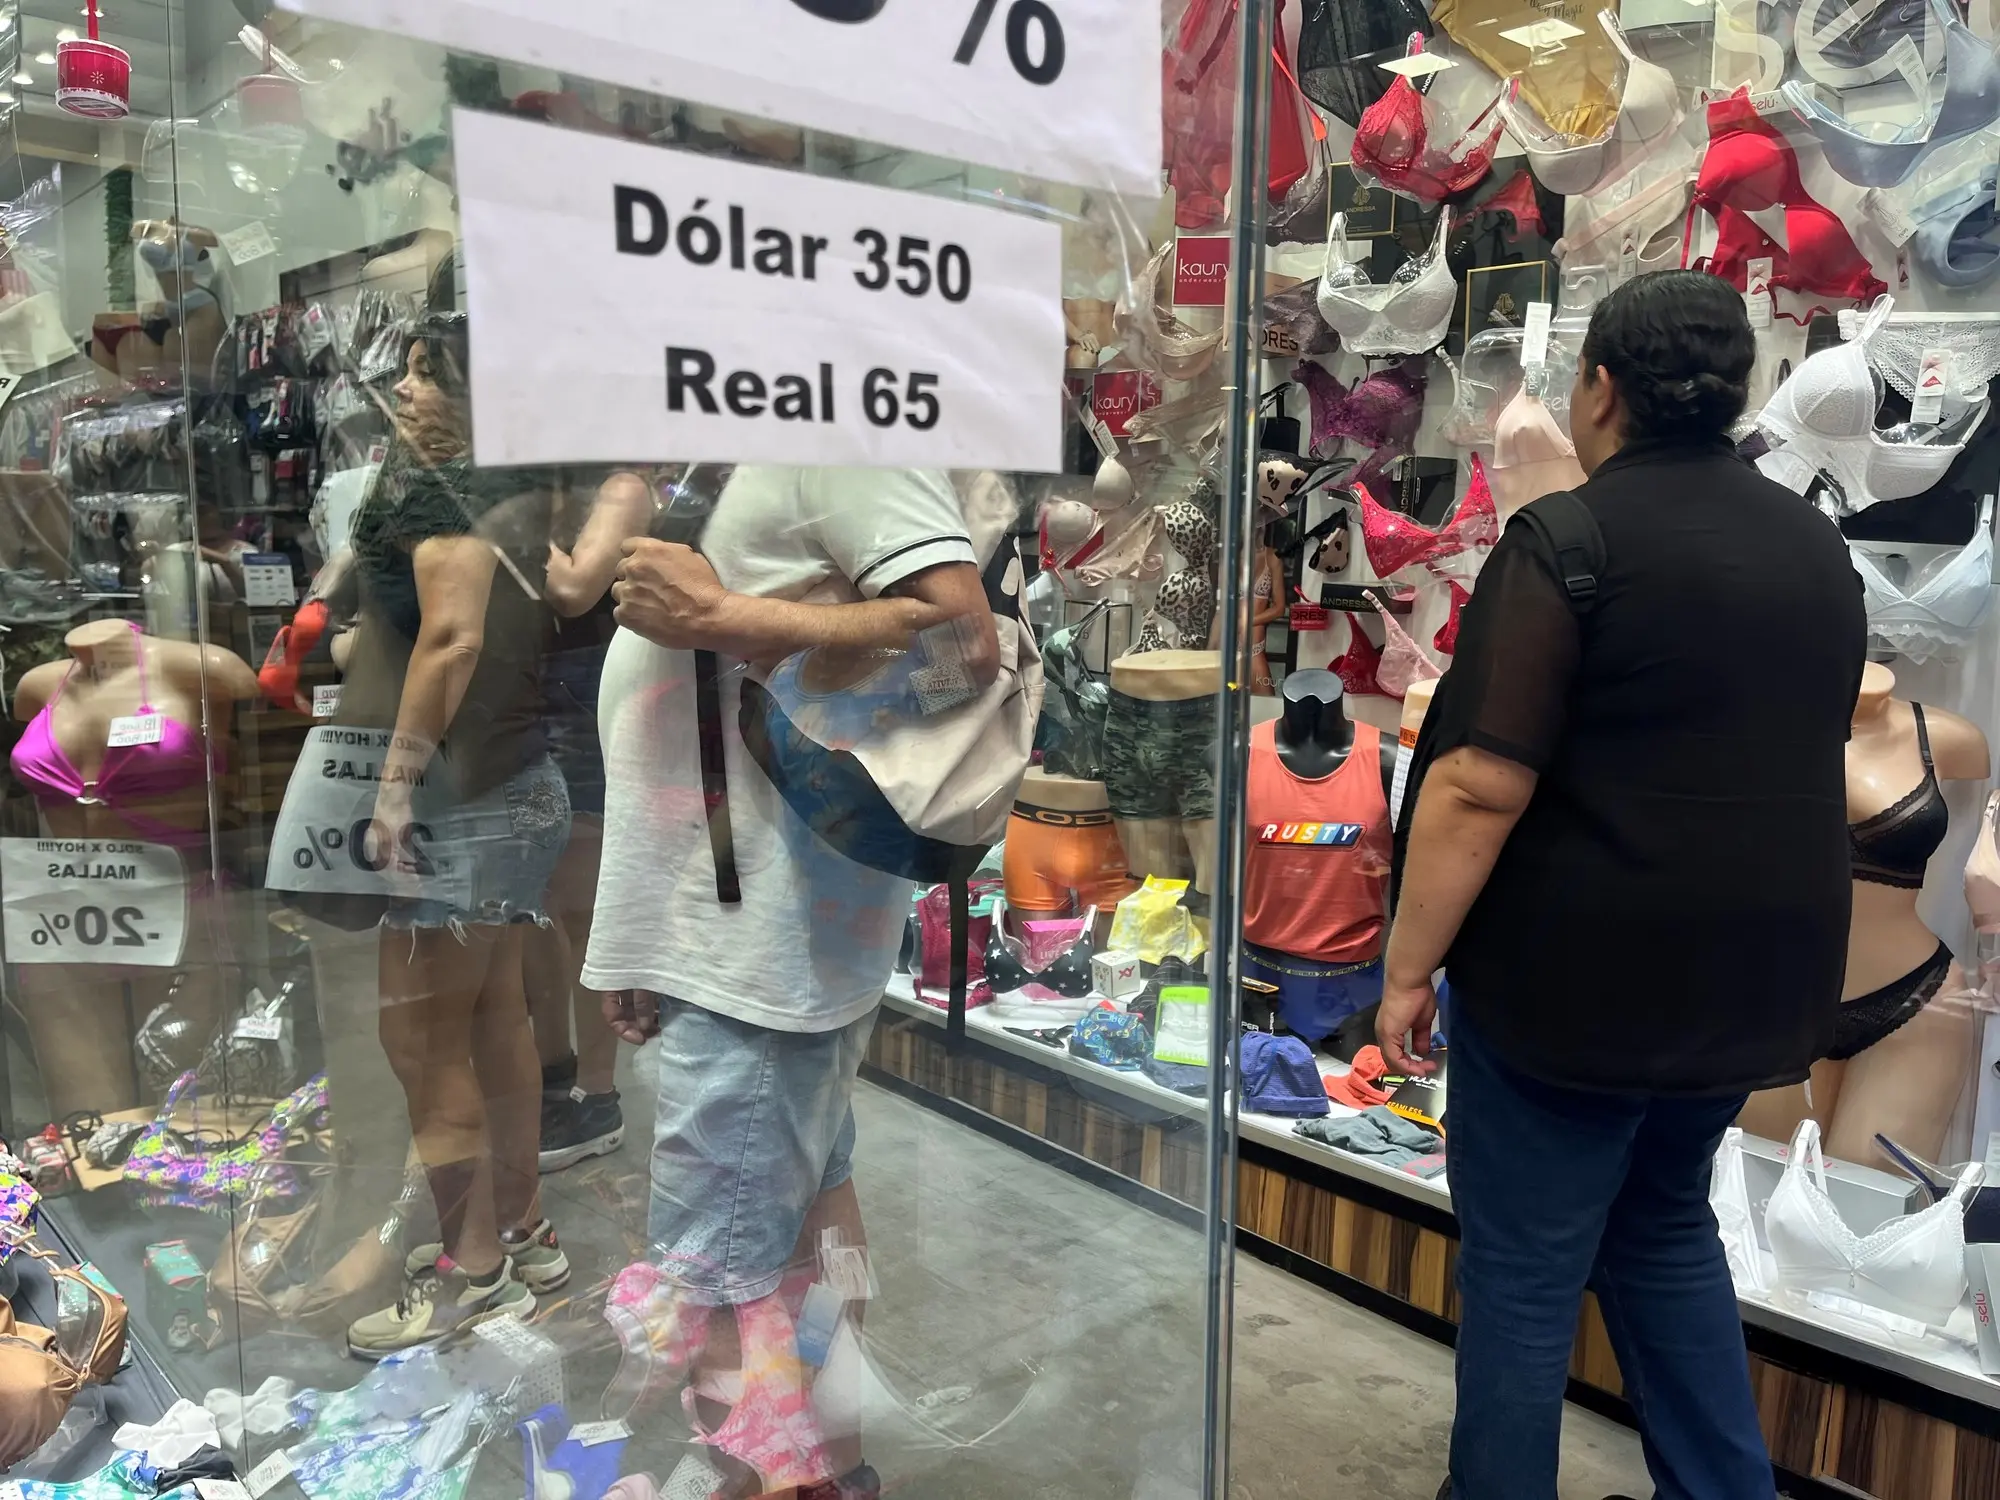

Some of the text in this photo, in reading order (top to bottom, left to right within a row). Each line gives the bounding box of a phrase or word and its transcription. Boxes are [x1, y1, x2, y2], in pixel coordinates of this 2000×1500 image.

[1345, 205, 1376, 213] ANDRESSA
[614, 184, 972, 303] Dólar 350
[1179, 258, 1232, 280] kaury
[665, 346, 940, 431] Real 65
[1095, 393, 1136, 412] kaury
[1400, 459, 1413, 514] NDRESSA
[1261, 823, 1358, 842] RUSTY
[1386, 1101, 1423, 1116] SEAMLESS
[1973, 1292, 1990, 1324] selú
